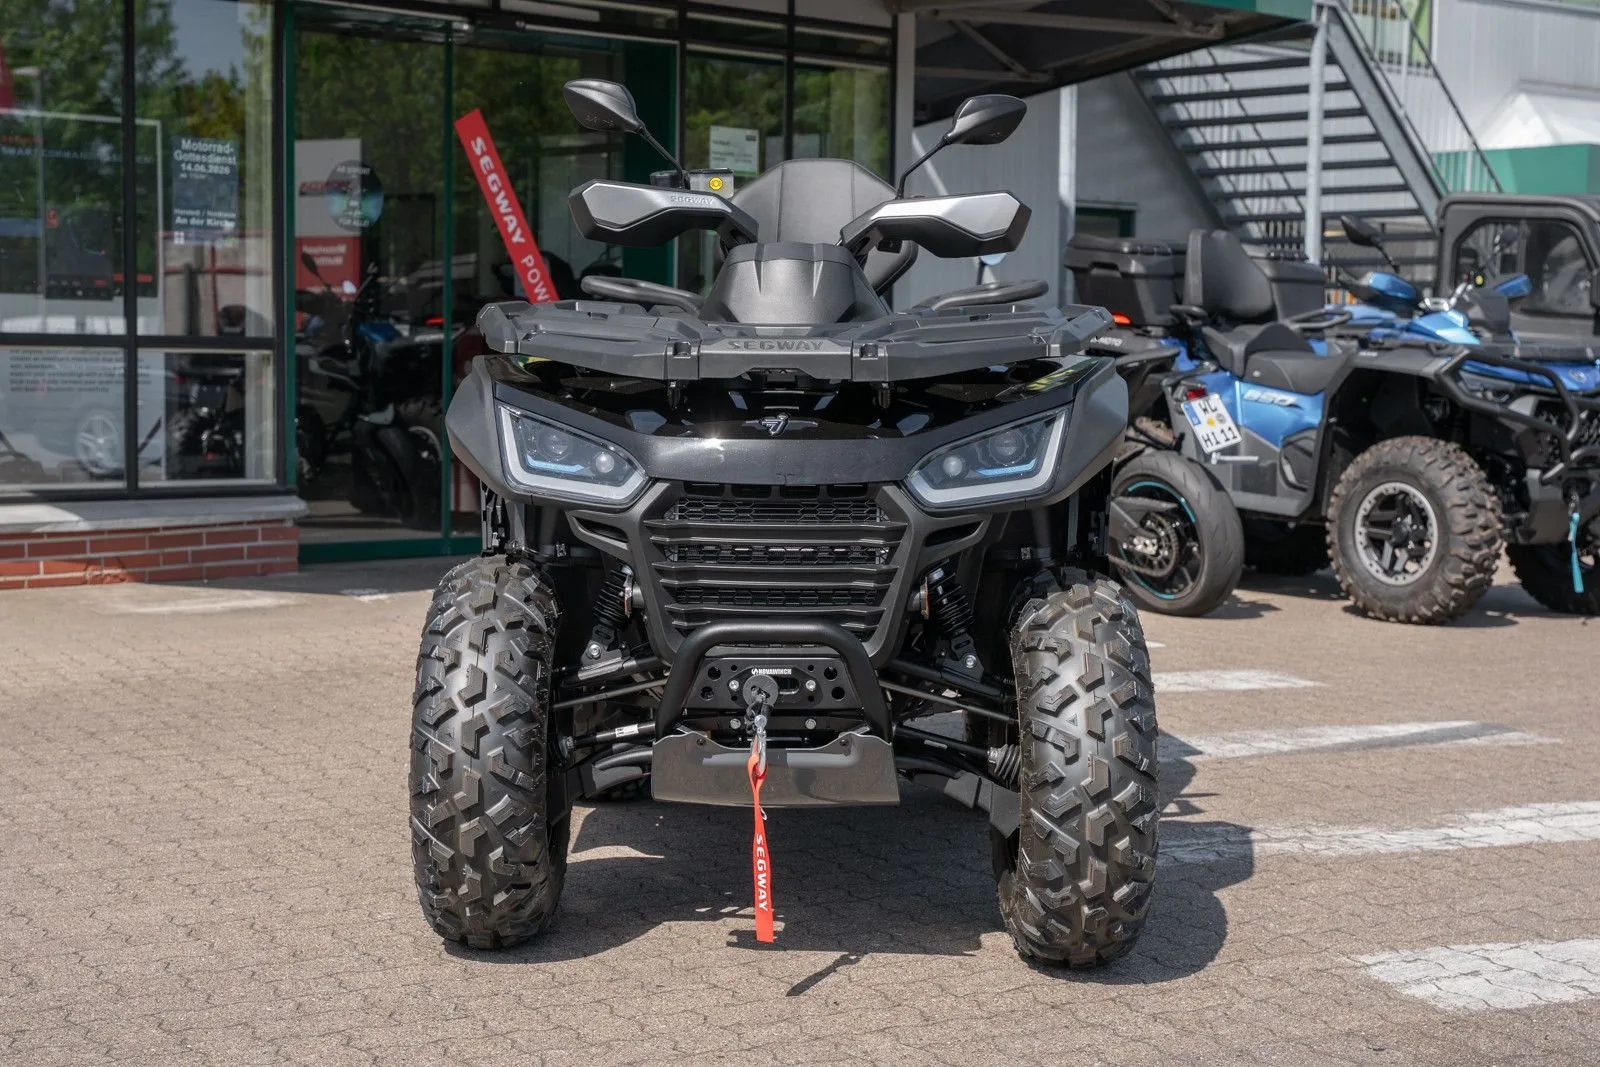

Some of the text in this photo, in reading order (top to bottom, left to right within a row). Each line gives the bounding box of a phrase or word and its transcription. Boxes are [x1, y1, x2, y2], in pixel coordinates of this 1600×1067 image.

[471, 136, 551, 302] SEGWAY POW
[670, 195, 713, 205] SEGWAY
[727, 340, 825, 352] SEGWAY
[756, 833, 768, 912] SEGWAY
